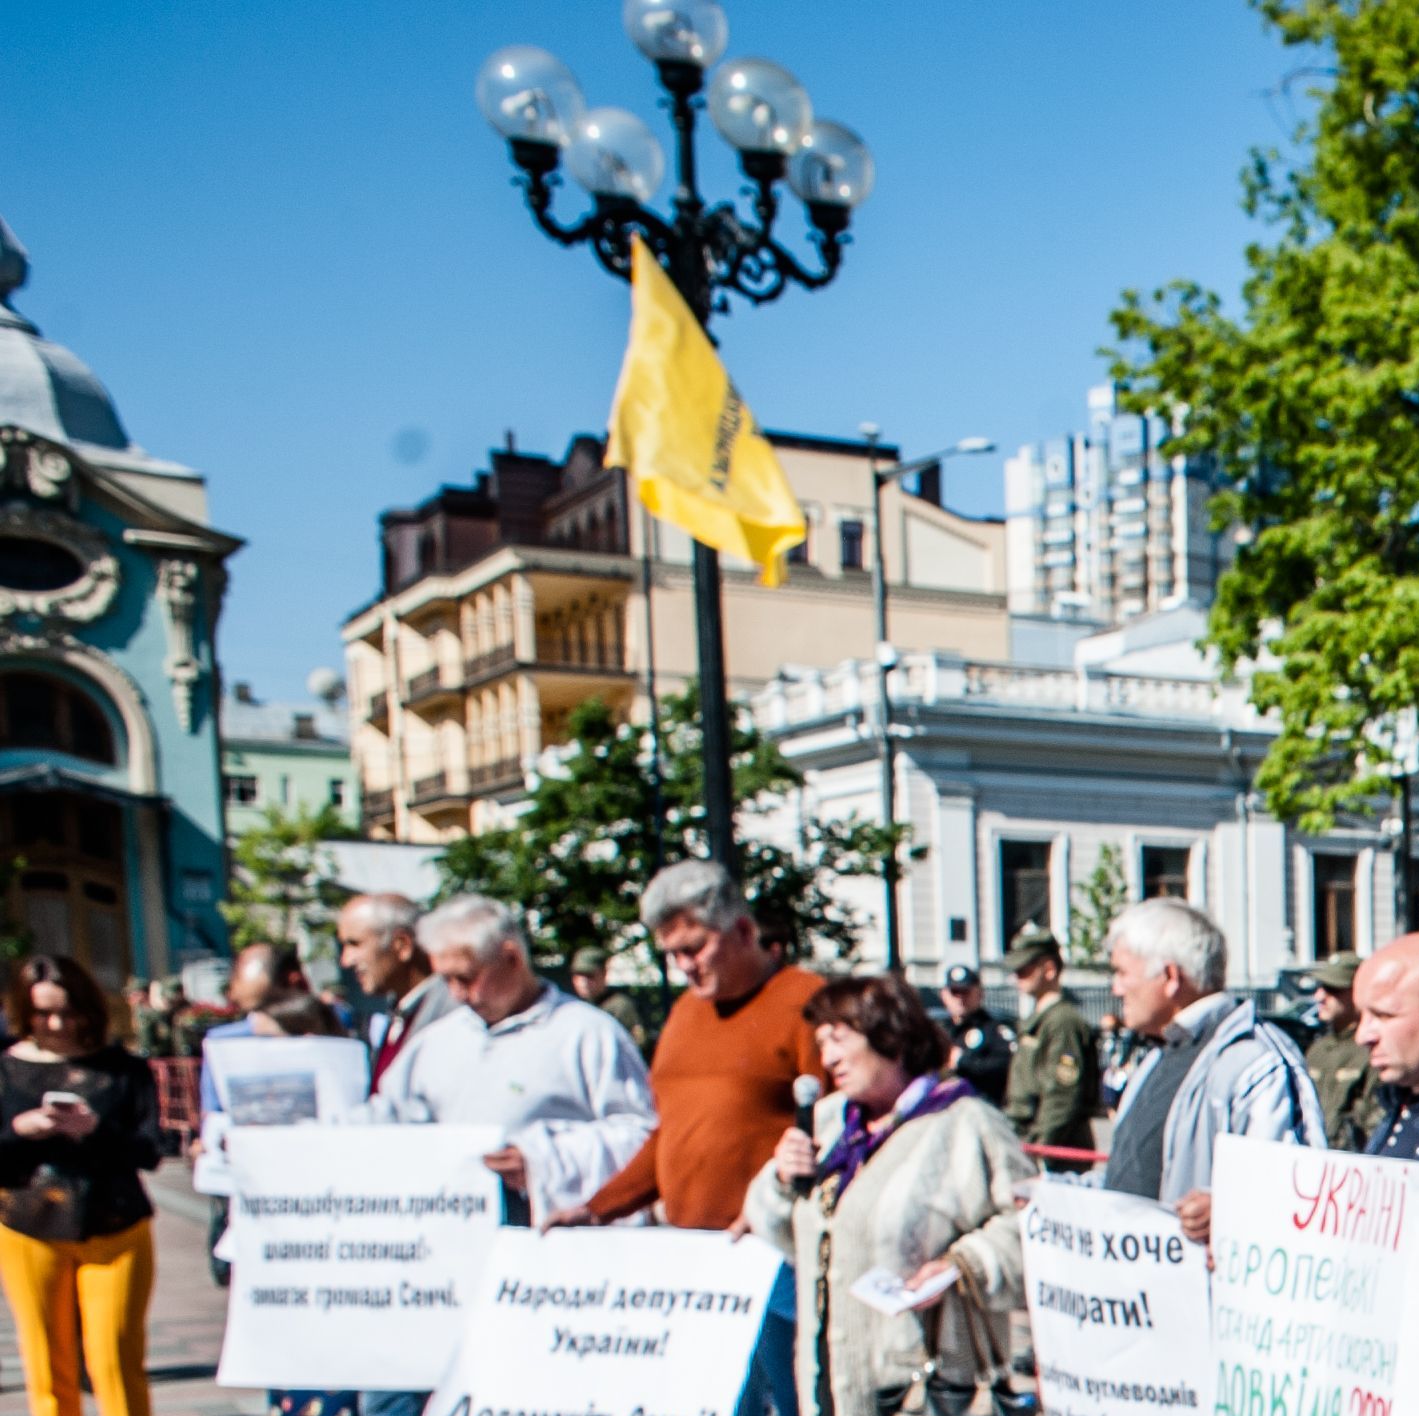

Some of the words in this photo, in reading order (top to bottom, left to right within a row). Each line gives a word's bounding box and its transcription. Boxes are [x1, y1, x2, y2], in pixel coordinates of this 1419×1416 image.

[1291, 1157, 1409, 1252] УКРАЇНІ
[1100, 1231, 1185, 1266] хоче
[496, 1278, 609, 1313] Народні
[610, 1286, 754, 1318] депутати
[549, 1325, 671, 1363] України!
